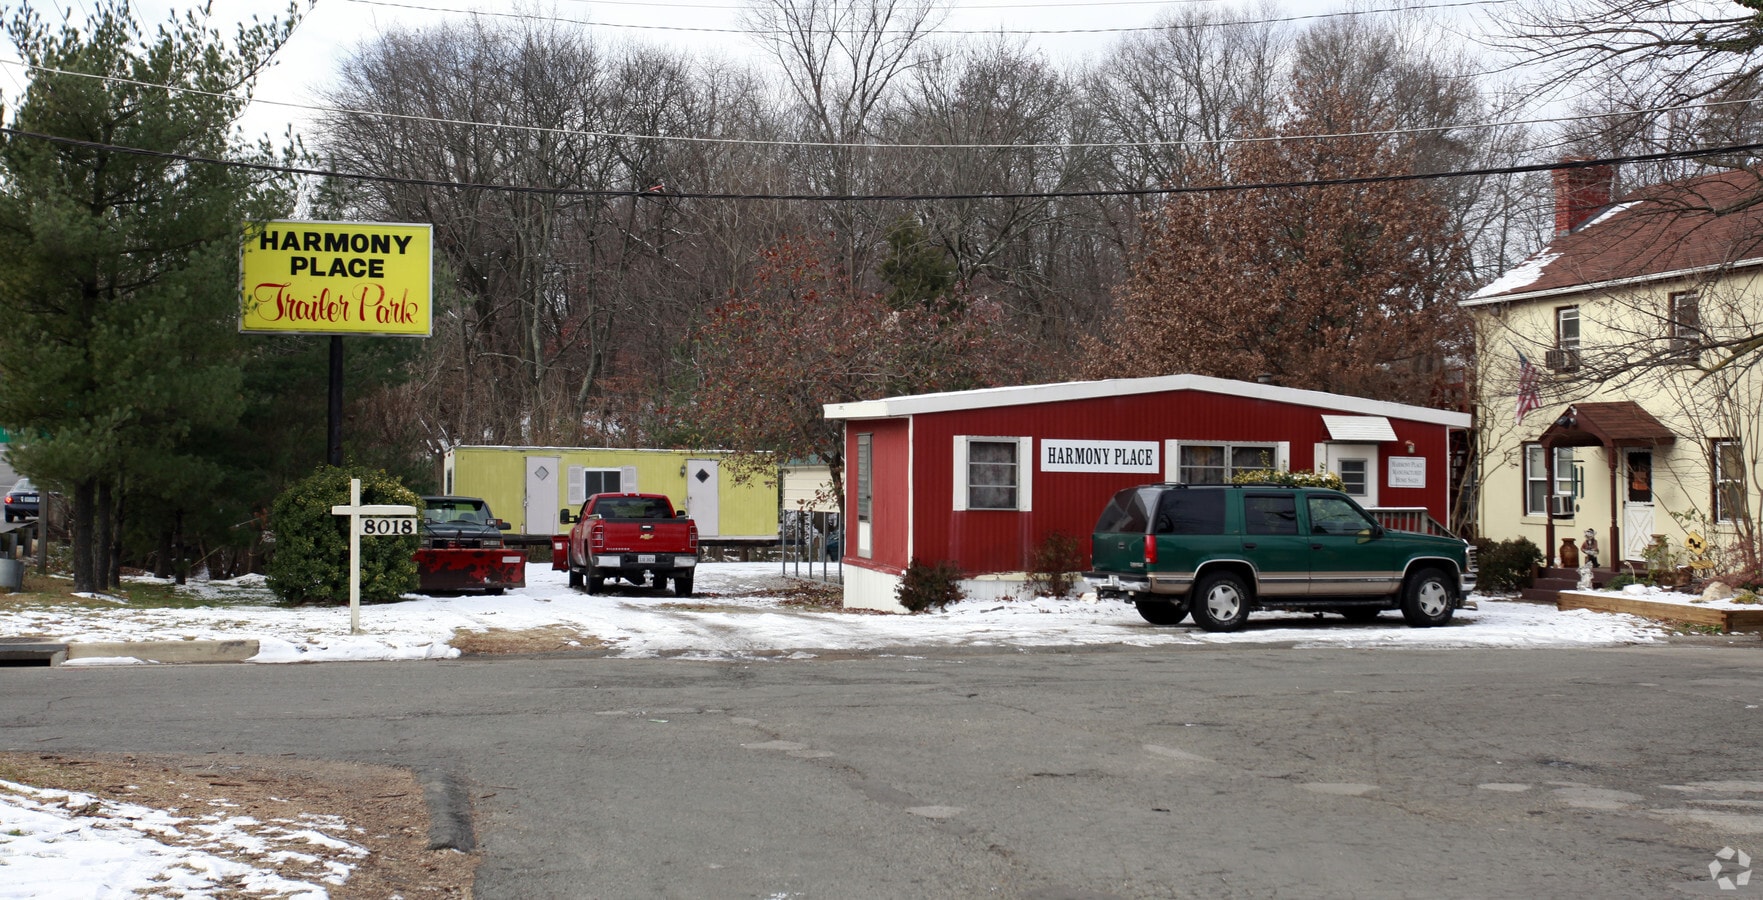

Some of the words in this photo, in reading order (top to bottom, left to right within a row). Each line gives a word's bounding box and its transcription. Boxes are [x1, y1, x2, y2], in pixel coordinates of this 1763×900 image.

[260, 231, 413, 254] HARMONY
[291, 256, 384, 278] PLACE
[254, 282, 350, 322] Trailer
[352, 283, 418, 324] Park
[1048, 447, 1110, 464] HARMONY
[1114, 448, 1153, 466] PLACE
[364, 519, 413, 535] 8018
